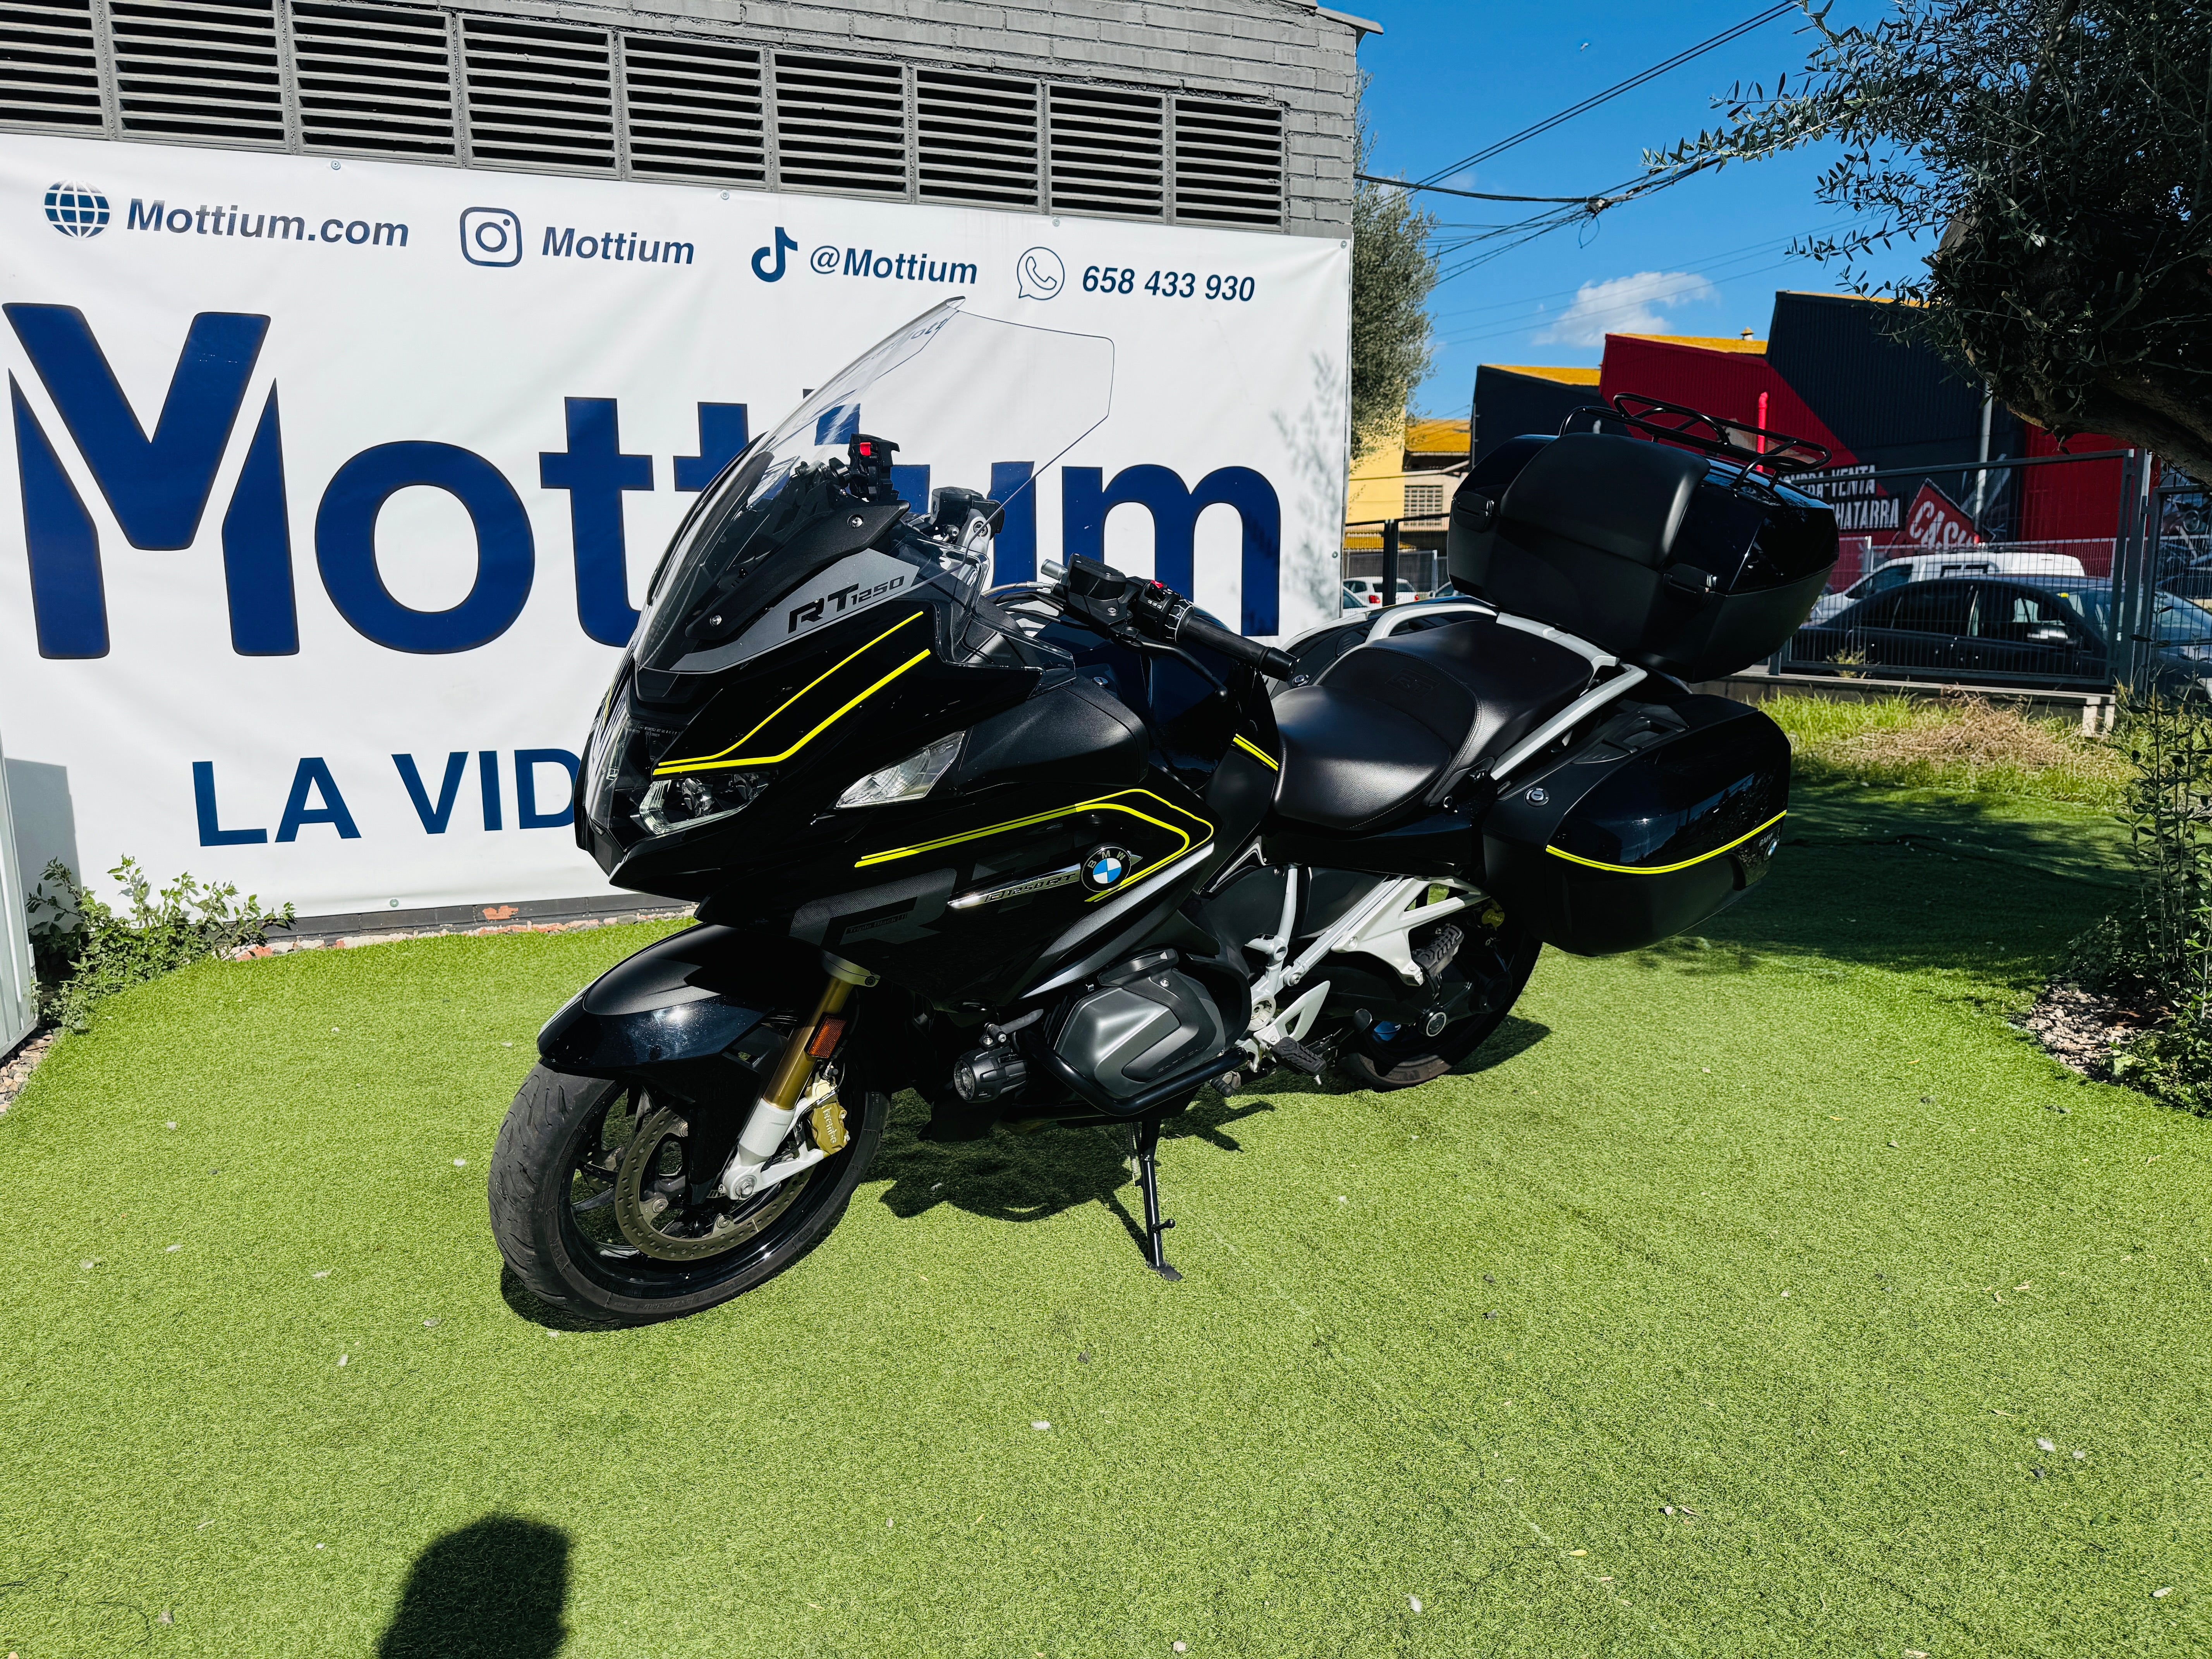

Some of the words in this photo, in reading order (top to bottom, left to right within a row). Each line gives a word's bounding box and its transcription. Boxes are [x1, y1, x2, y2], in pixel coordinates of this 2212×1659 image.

[127, 199, 408, 247] Mottium.com
[542, 227, 694, 264] Mottium
[810, 246, 977, 284] @Mottium
[1083, 266, 1135, 294] 658
[1144, 271, 1195, 298] 433
[1205, 274, 1255, 302] 930
[2, 302, 1281, 659] Motm
[192, 757, 362, 847] LA
[1087, 850, 1126, 869] BMW
[874, 917, 896, 927] Black
[823, 1107, 837, 1144] brembo
